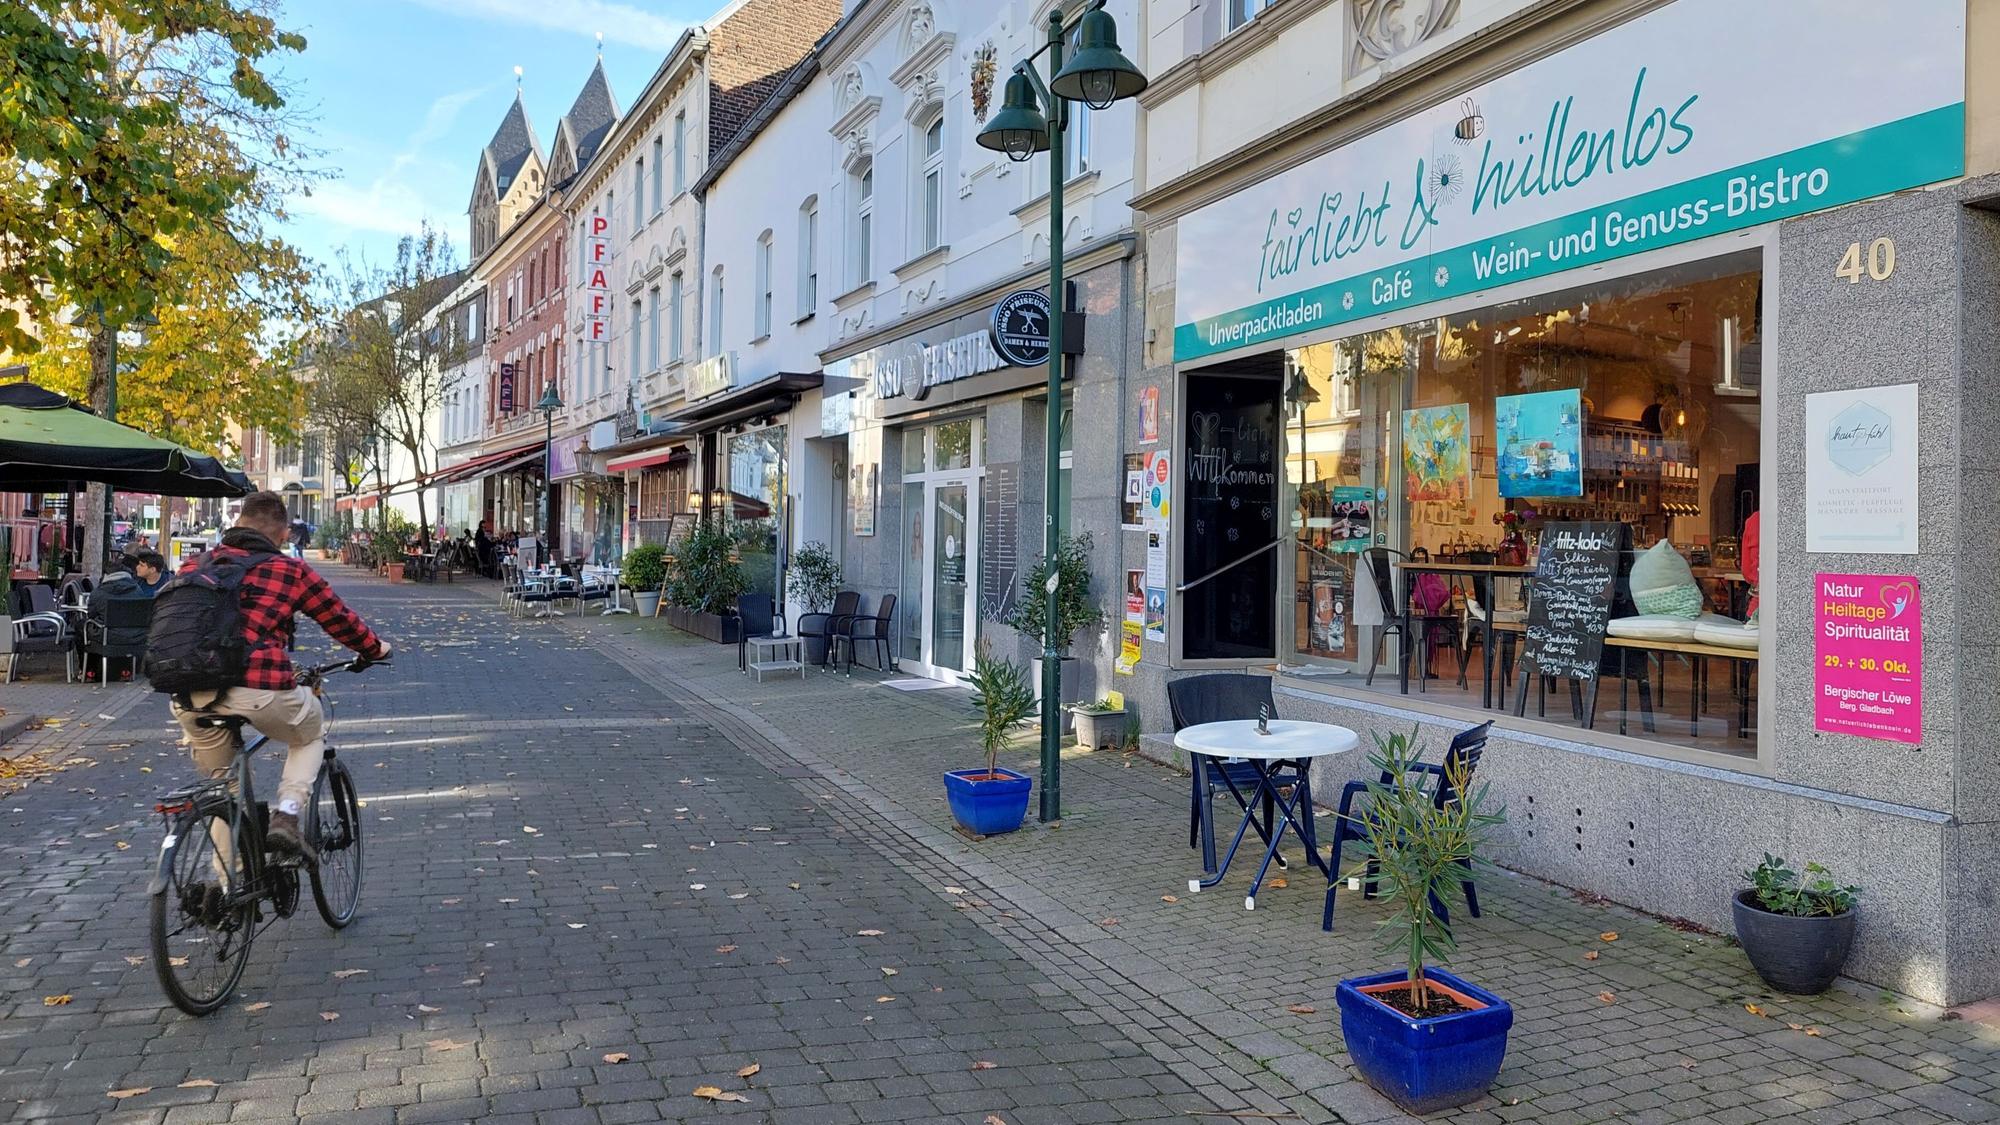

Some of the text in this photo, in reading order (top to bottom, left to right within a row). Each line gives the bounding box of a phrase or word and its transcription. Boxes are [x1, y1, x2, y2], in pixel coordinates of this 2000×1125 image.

[1257, 66, 1700, 294] fairliebt & hüllenlos
[1472, 166, 1829, 281] Wein- und Genuss-Bistro
[1835, 236, 1896, 284] 40
[591, 216, 608, 340] PFAFF
[1371, 270, 1413, 306] Café
[1000, 297, 1051, 332] ISSO FRISEURS
[1208, 299, 1323, 346] Unverpacktladen
[1004, 338, 1024, 346] DAMEN
[502, 366, 513, 409] CAFE
[1187, 444, 1275, 486] Willkommen
[1556, 530, 1602, 551] fritz-kola
[1823, 582, 1864, 598] Natur
[1823, 601, 1886, 622] Heiltage
[1824, 621, 1910, 642] Spiritualität
[1824, 655, 1911, 674] 29. + 30. Okt.
[1824, 684, 1912, 705] Bergischer Löwe
[1839, 701, 1895, 715] Berg. Gladbach
